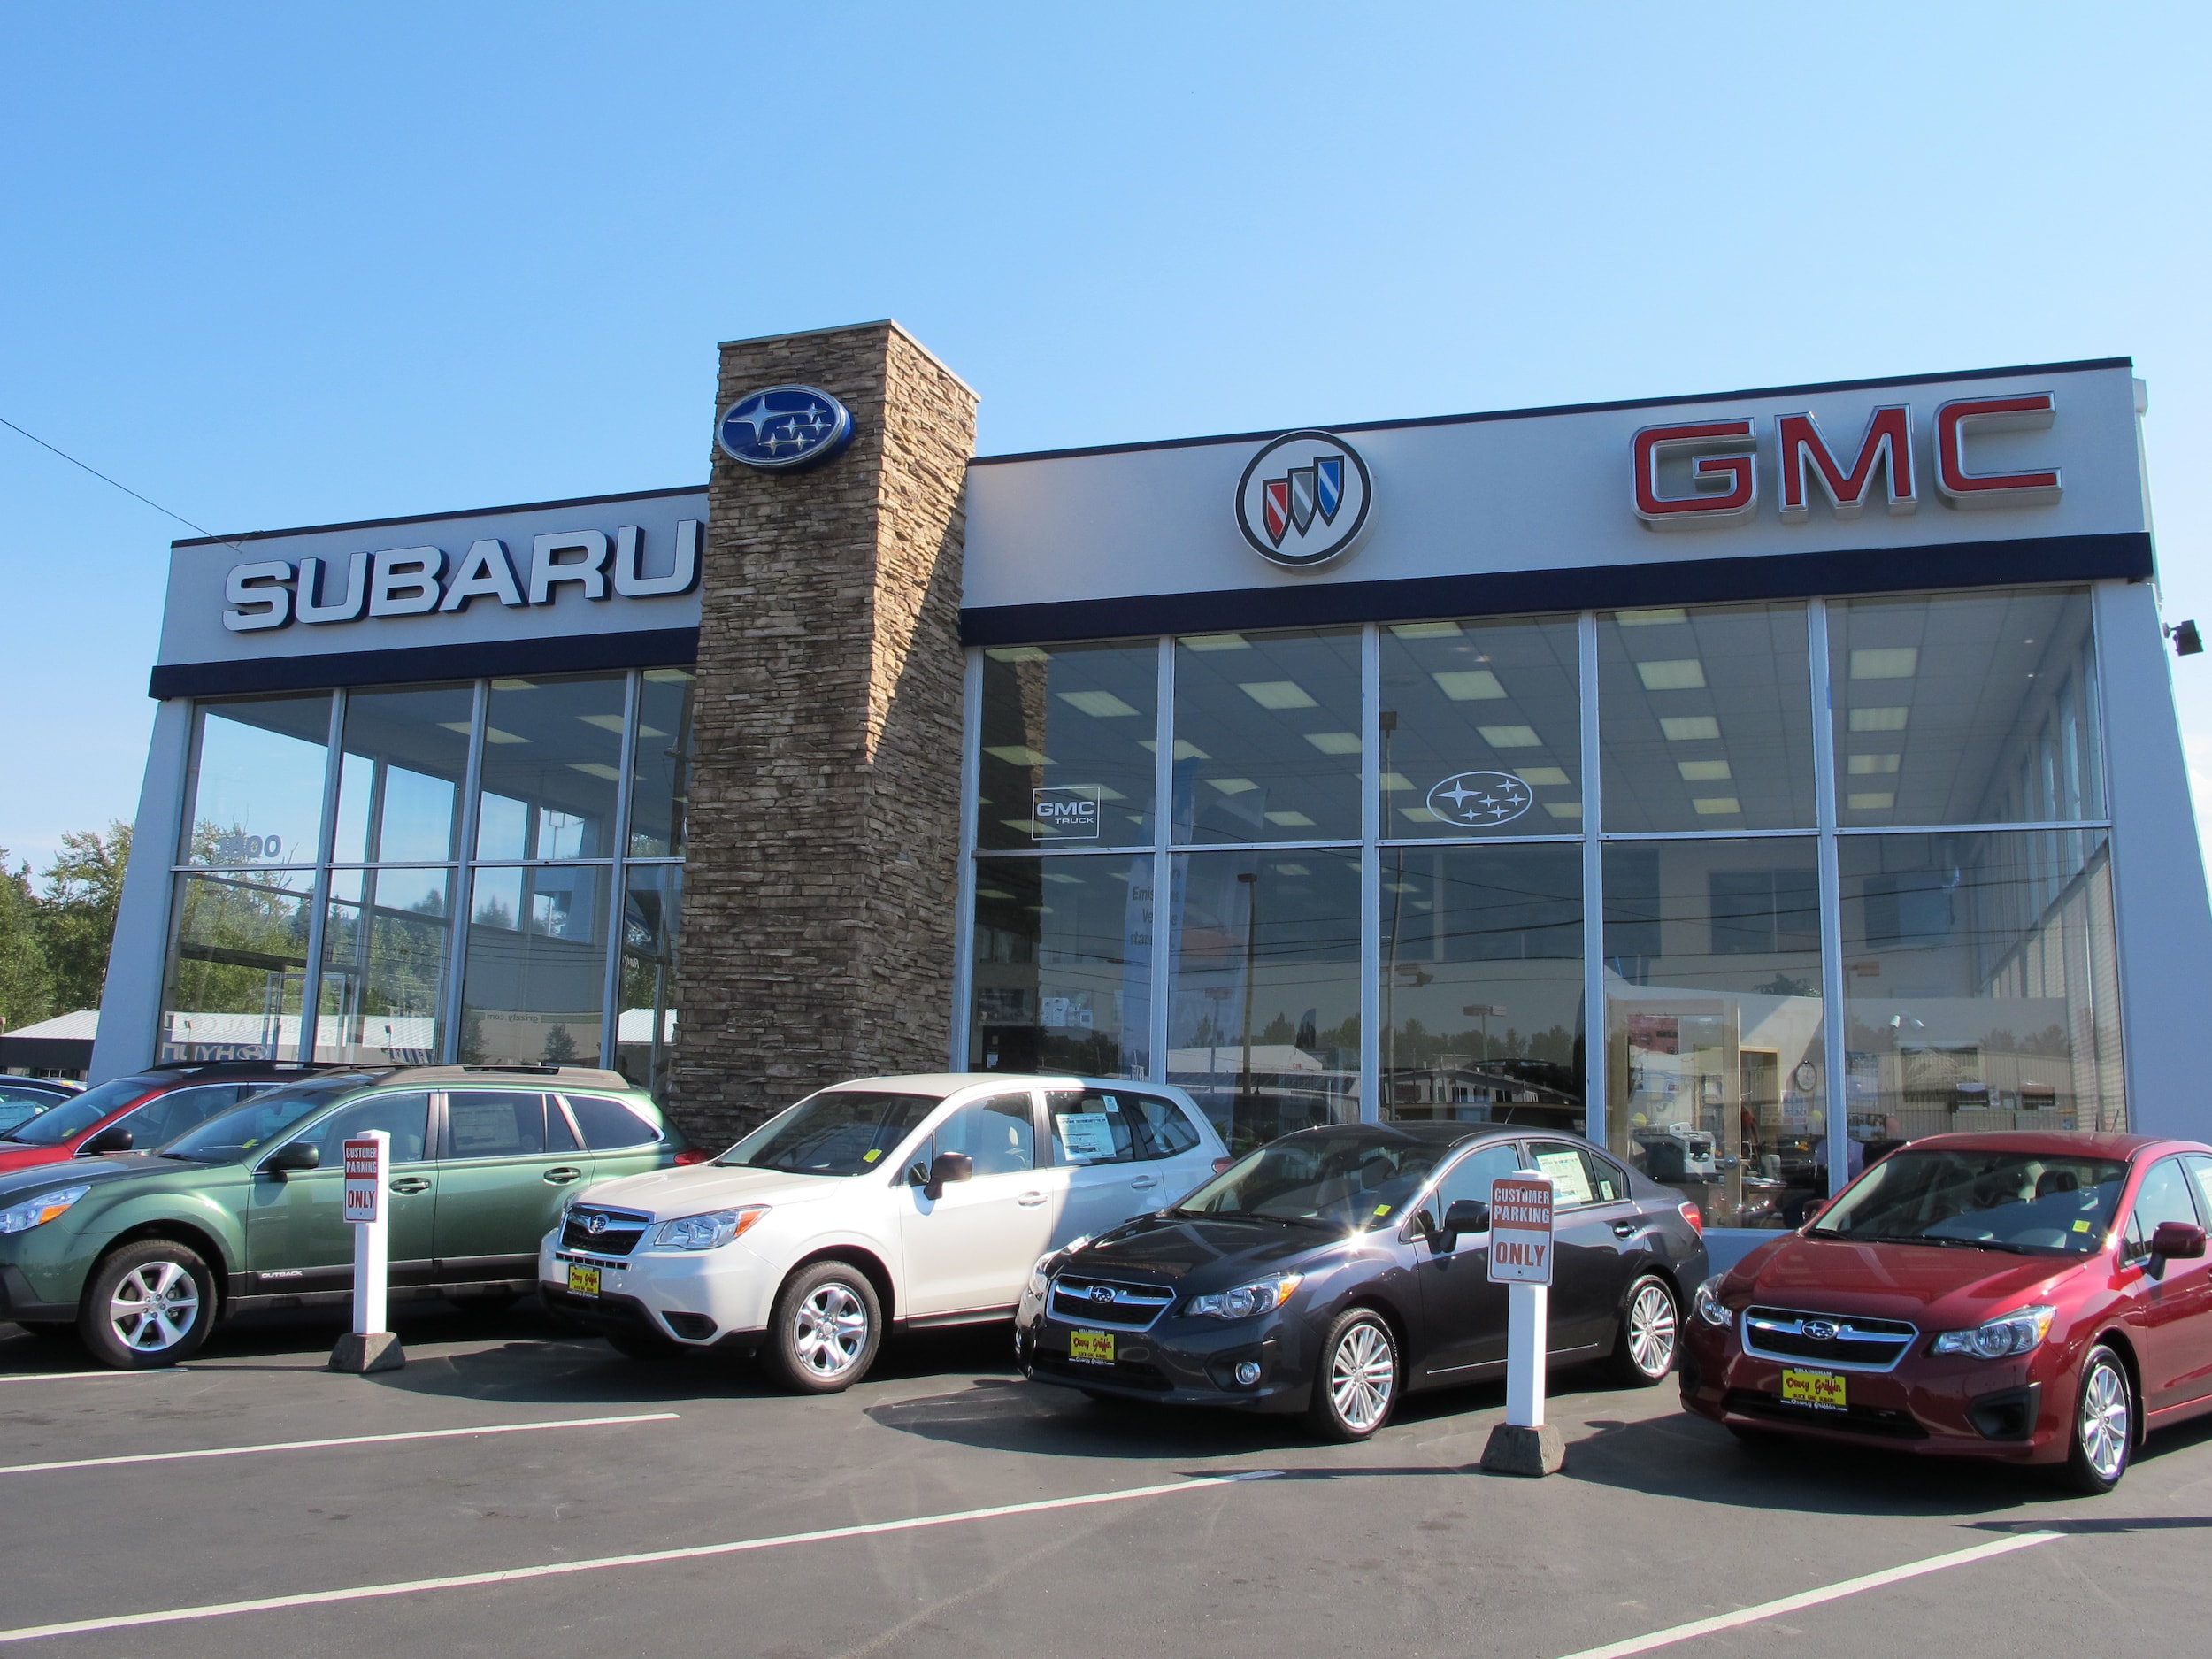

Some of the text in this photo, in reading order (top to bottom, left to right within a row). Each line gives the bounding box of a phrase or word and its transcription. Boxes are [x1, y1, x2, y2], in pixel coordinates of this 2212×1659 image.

[1629, 391, 2063, 530] GMC
[222, 519, 704, 632] SUBARU
[1036, 801, 1095, 817] GMC
[345, 1147, 378, 1159] CUSTOMER
[345, 1161, 377, 1174] PARKING
[348, 1190, 375, 1209] ONLY
[1494, 1187, 1550, 1204] CUSTOMER
[1494, 1205, 1550, 1224] PARKING
[1495, 1241, 1546, 1267] ONLY
[1794, 1367, 1832, 1376] BELLINGHAM
[1815, 1379, 1841, 1395] Griffin
